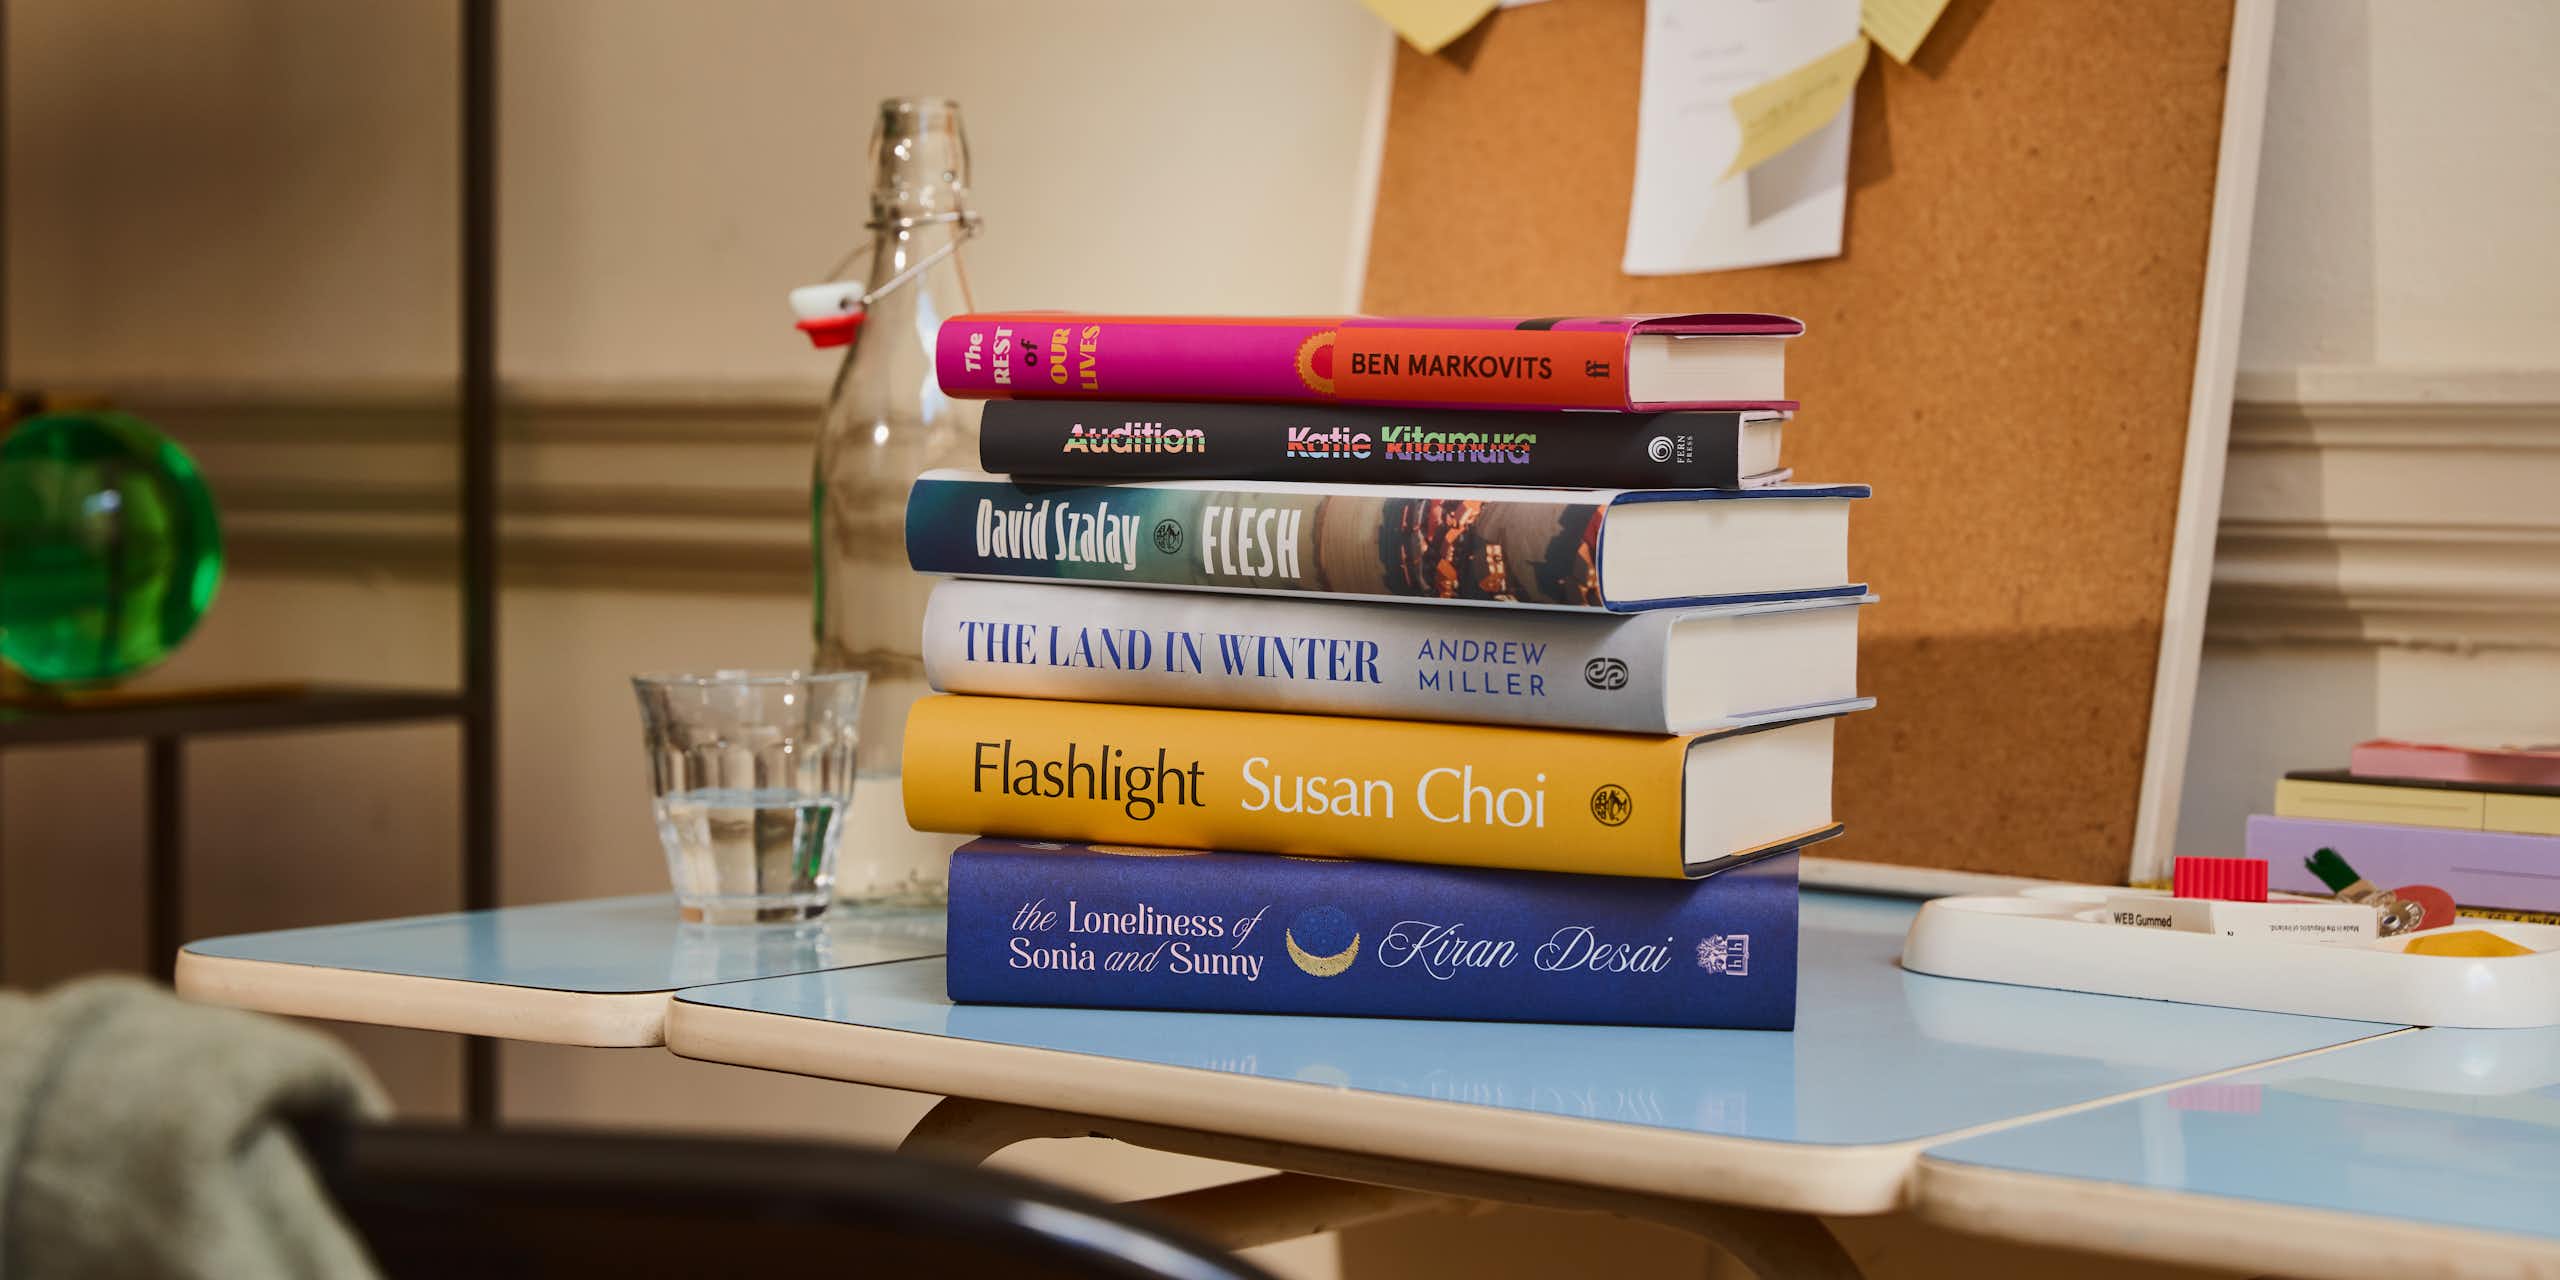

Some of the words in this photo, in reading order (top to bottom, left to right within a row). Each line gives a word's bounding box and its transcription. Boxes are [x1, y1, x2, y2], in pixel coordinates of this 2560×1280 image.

[964, 332, 983, 372] The
[992, 325, 1013, 385] REST
[1020, 338, 1038, 367] of
[1050, 327, 1071, 385] OUR
[1079, 325, 1101, 390] LIVES
[1351, 353, 1399, 376] BEN
[1408, 354, 1553, 380] MARKOVITS
[1062, 422, 1207, 453] Audition
[1287, 427, 1372, 459] Katie
[1381, 426, 1537, 465] Kitamura
[1677, 435, 1686, 463] FERN
[976, 498, 1050, 561] David
[1054, 501, 1140, 571] Szalay
[1202, 506, 1302, 578] FLESH
[959, 621, 1038, 665] THE
[1047, 625, 1153, 671] LAND
[1162, 631, 1204, 674] IN
[1217, 633, 1384, 684] WINTER
[1417, 638, 1547, 666] ANDREW
[1418, 670, 1547, 697] MILLER
[973, 739, 1207, 821] Flashlight
[1240, 757, 1394, 819] Susan
[1417, 765, 1547, 828] Choi
[1011, 898, 1058, 932] the
[1069, 901, 1224, 938] Loneliness
[1231, 904, 1271, 950] of
[2113, 911, 2135, 925] WEB
[2136, 914, 2172, 928] Gummed
[1008, 937, 1097, 972] Sonia
[1103, 940, 1171, 973] and
[1169, 942, 1265, 982] Sunny
[1378, 920, 1518, 980] Kiran
[1533, 926, 1674, 974] Desai
